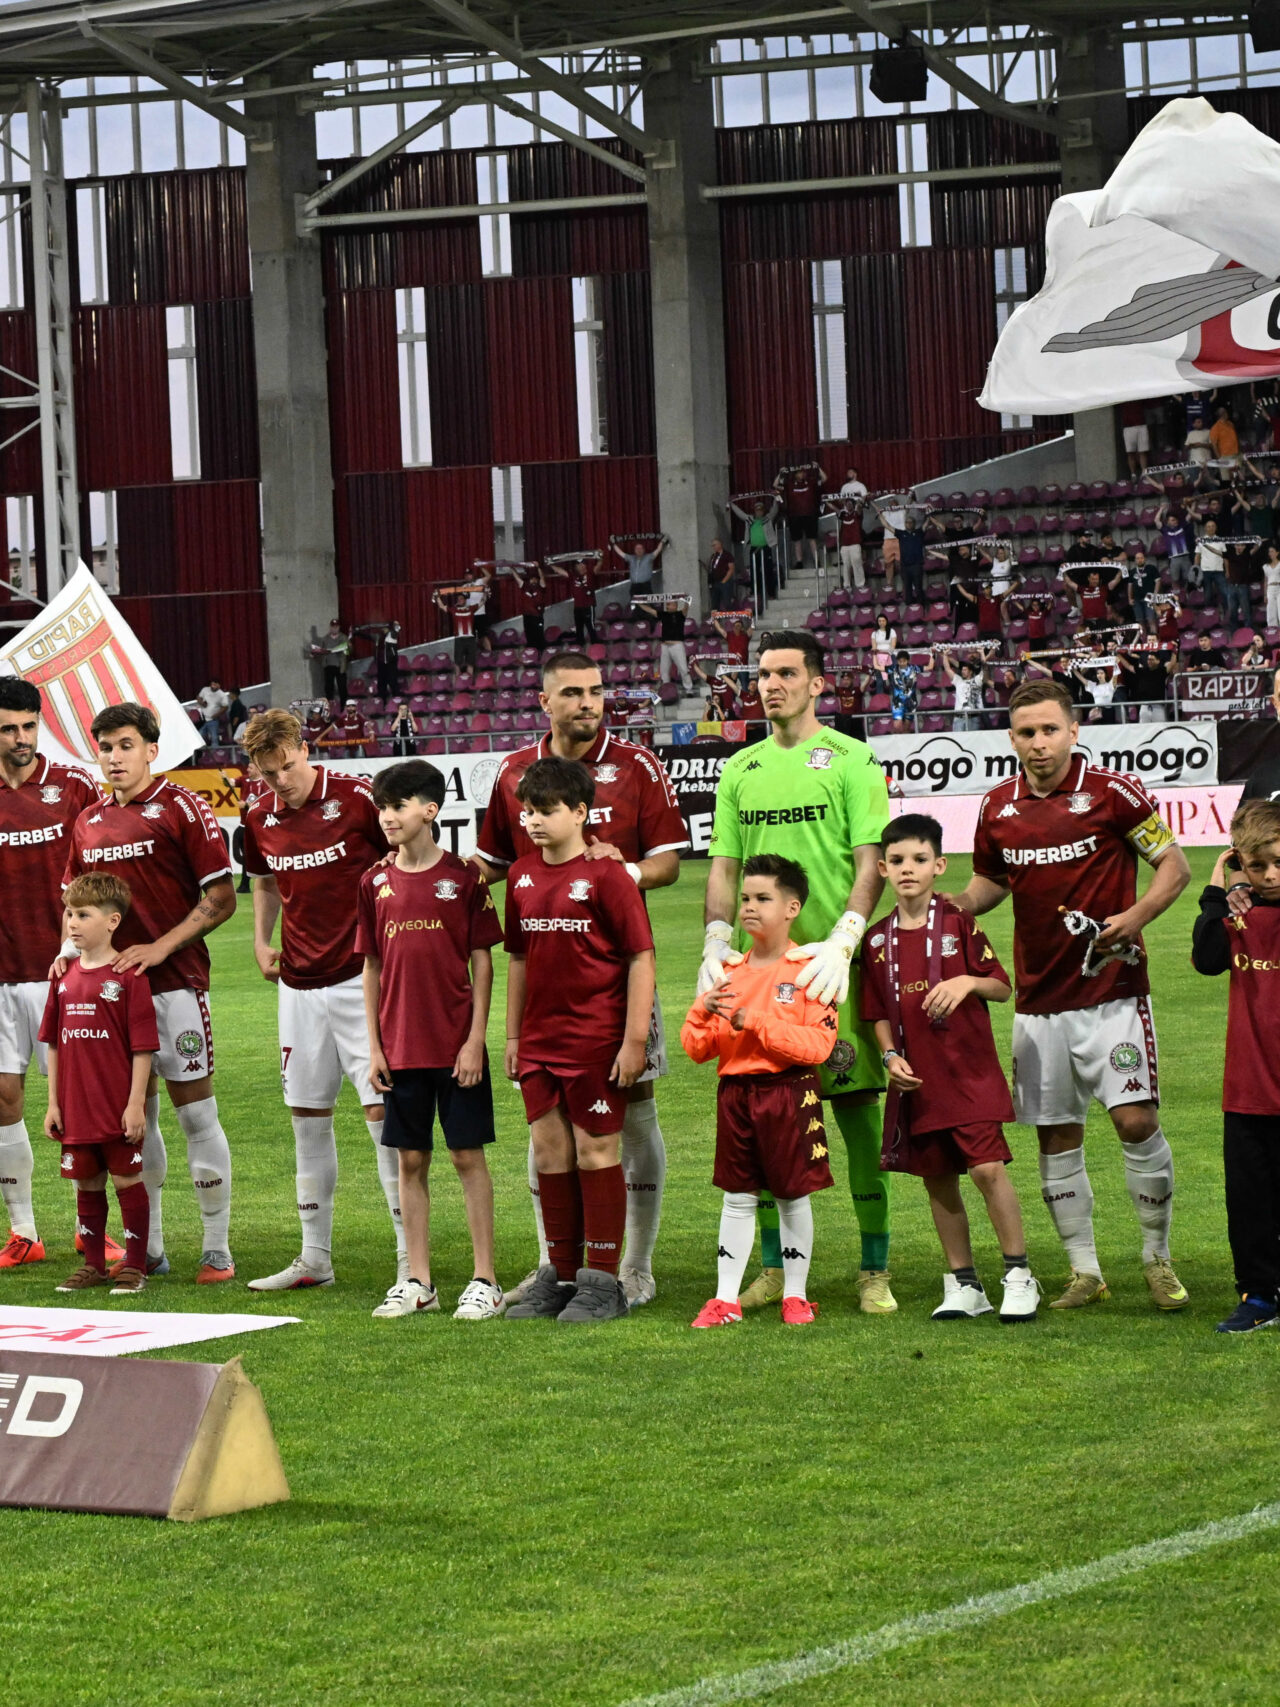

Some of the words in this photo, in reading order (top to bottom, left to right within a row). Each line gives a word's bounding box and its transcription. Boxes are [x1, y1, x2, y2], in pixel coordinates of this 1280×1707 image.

[1187, 675, 1259, 699] RAPID
[1101, 747, 1209, 783] mogo
[1112, 782, 1141, 808] IMAMED
[179, 798, 196, 823] IMAMED
[739, 804, 828, 826] SUPERBET
[82, 839, 155, 864] SUPERBET
[265, 841, 347, 871] SUPERBET
[1002, 835, 1097, 866] SUPERBET
[396, 919, 444, 932] VEOLIA
[67, 1028, 110, 1039] VEOLIA
[281, 1046, 293, 1071] 7
[632, 1183, 657, 1192] RAPID
[594, 1242, 616, 1250] RAPID
